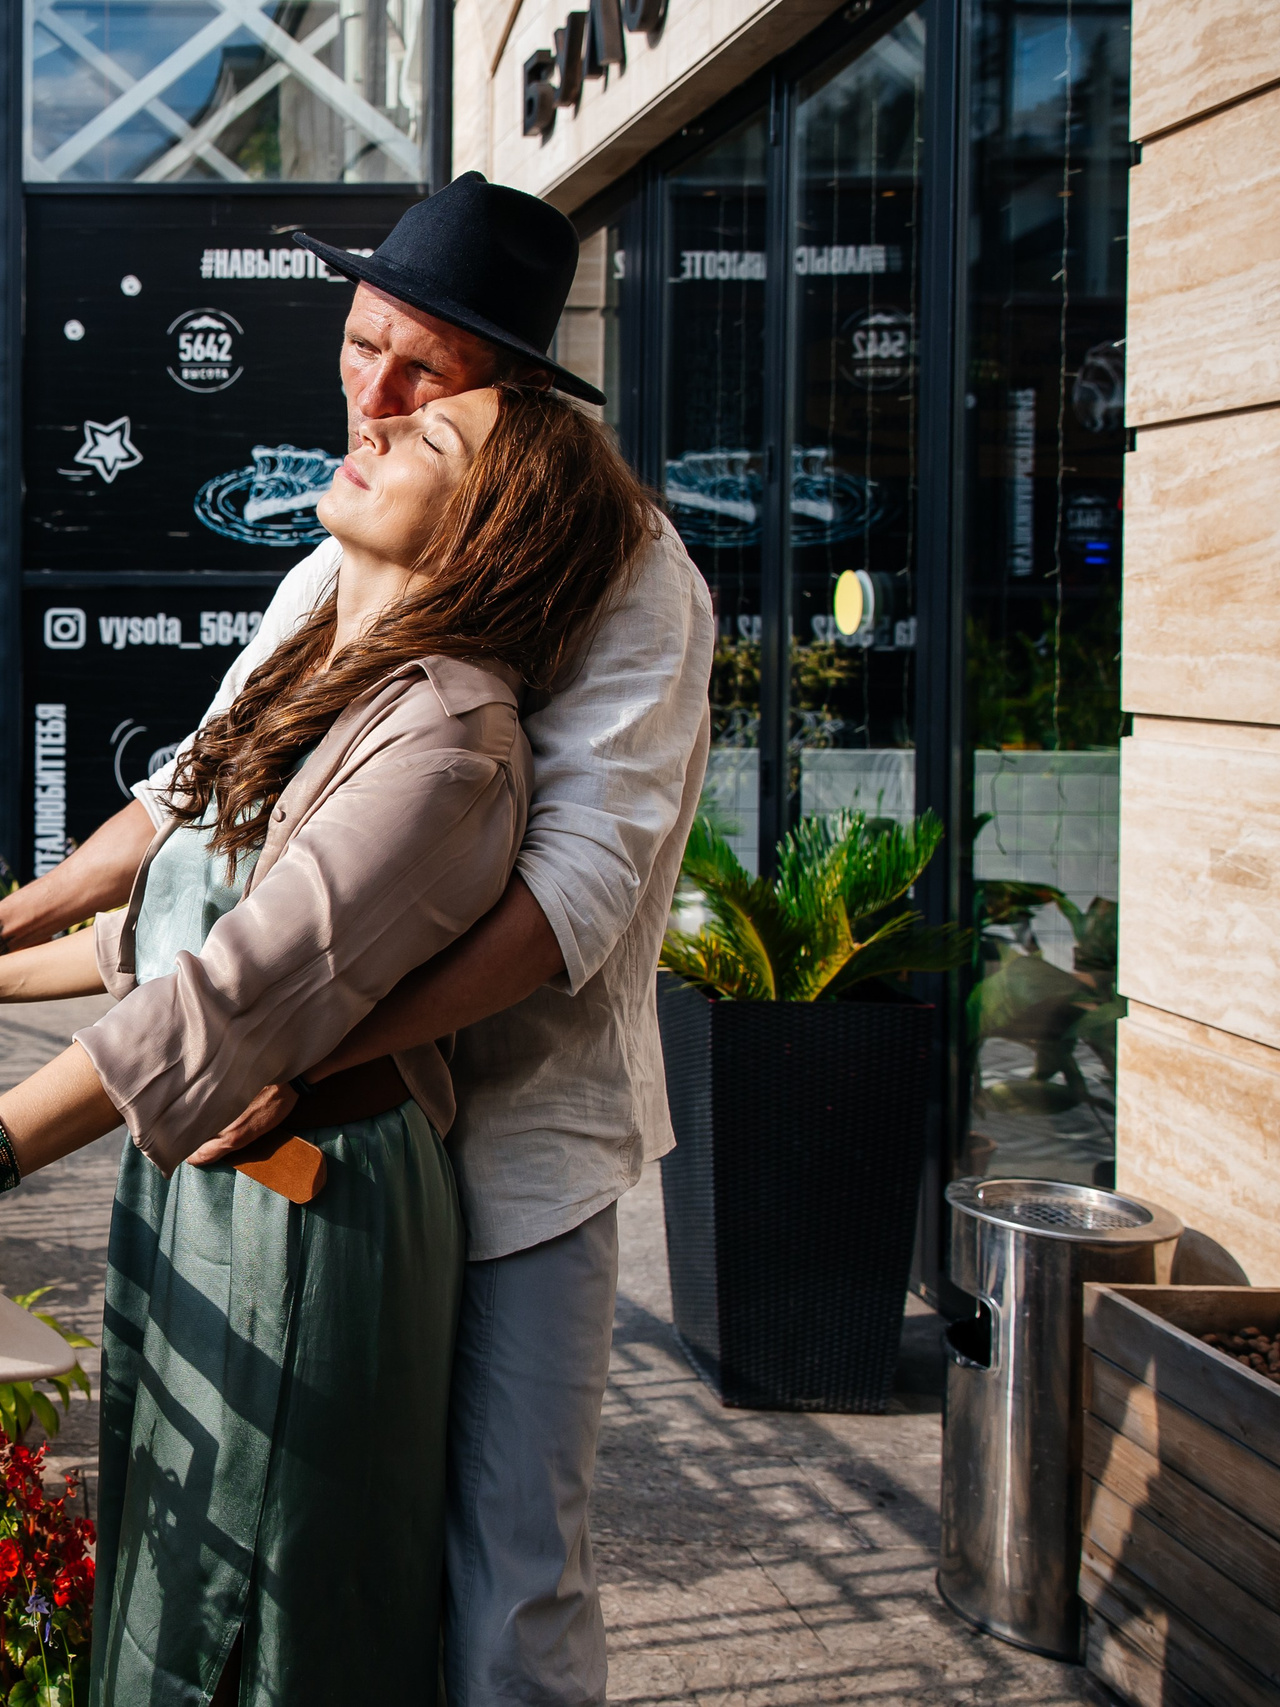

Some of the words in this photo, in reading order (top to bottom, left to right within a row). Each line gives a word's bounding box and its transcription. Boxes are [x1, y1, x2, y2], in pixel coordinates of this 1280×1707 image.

[200, 248, 376, 282] #НАВЫСОТЕ_
[179, 332, 233, 362] 5642
[181, 367, 229, 380] ВЫСОТА
[98, 610, 265, 650] vysota_5642
